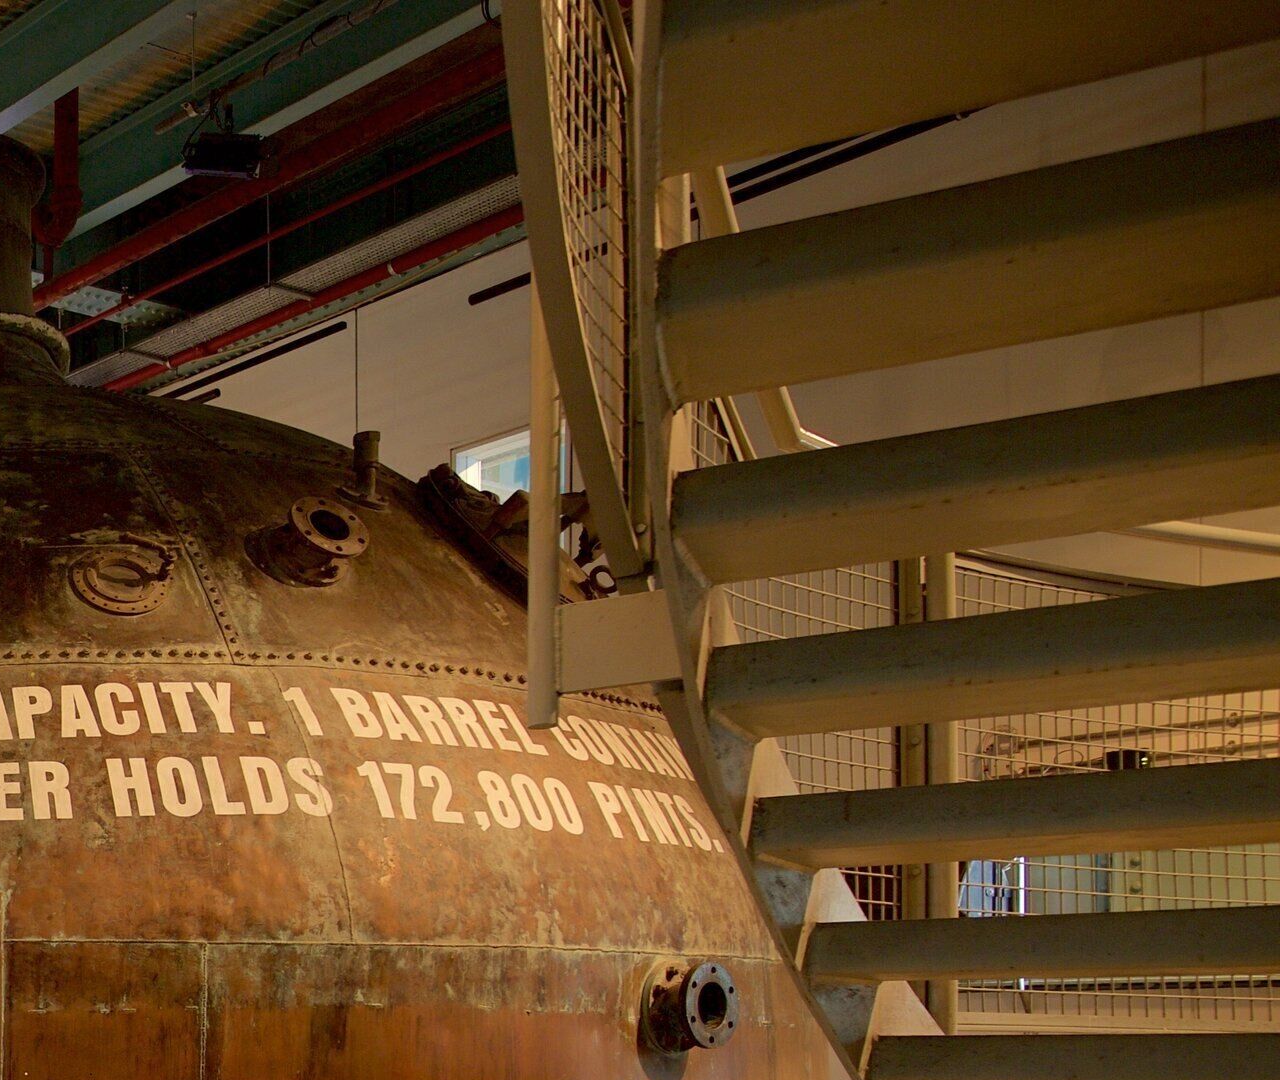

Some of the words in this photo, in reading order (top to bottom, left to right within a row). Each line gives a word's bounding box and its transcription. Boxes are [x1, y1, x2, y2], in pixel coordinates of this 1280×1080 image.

[282, 686, 325, 737] 1
[329, 687, 549, 757] BARREL
[105, 755, 334, 818] HOLDS
[356, 760, 584, 835] 172,800
[587, 781, 725, 853] PINTS.
